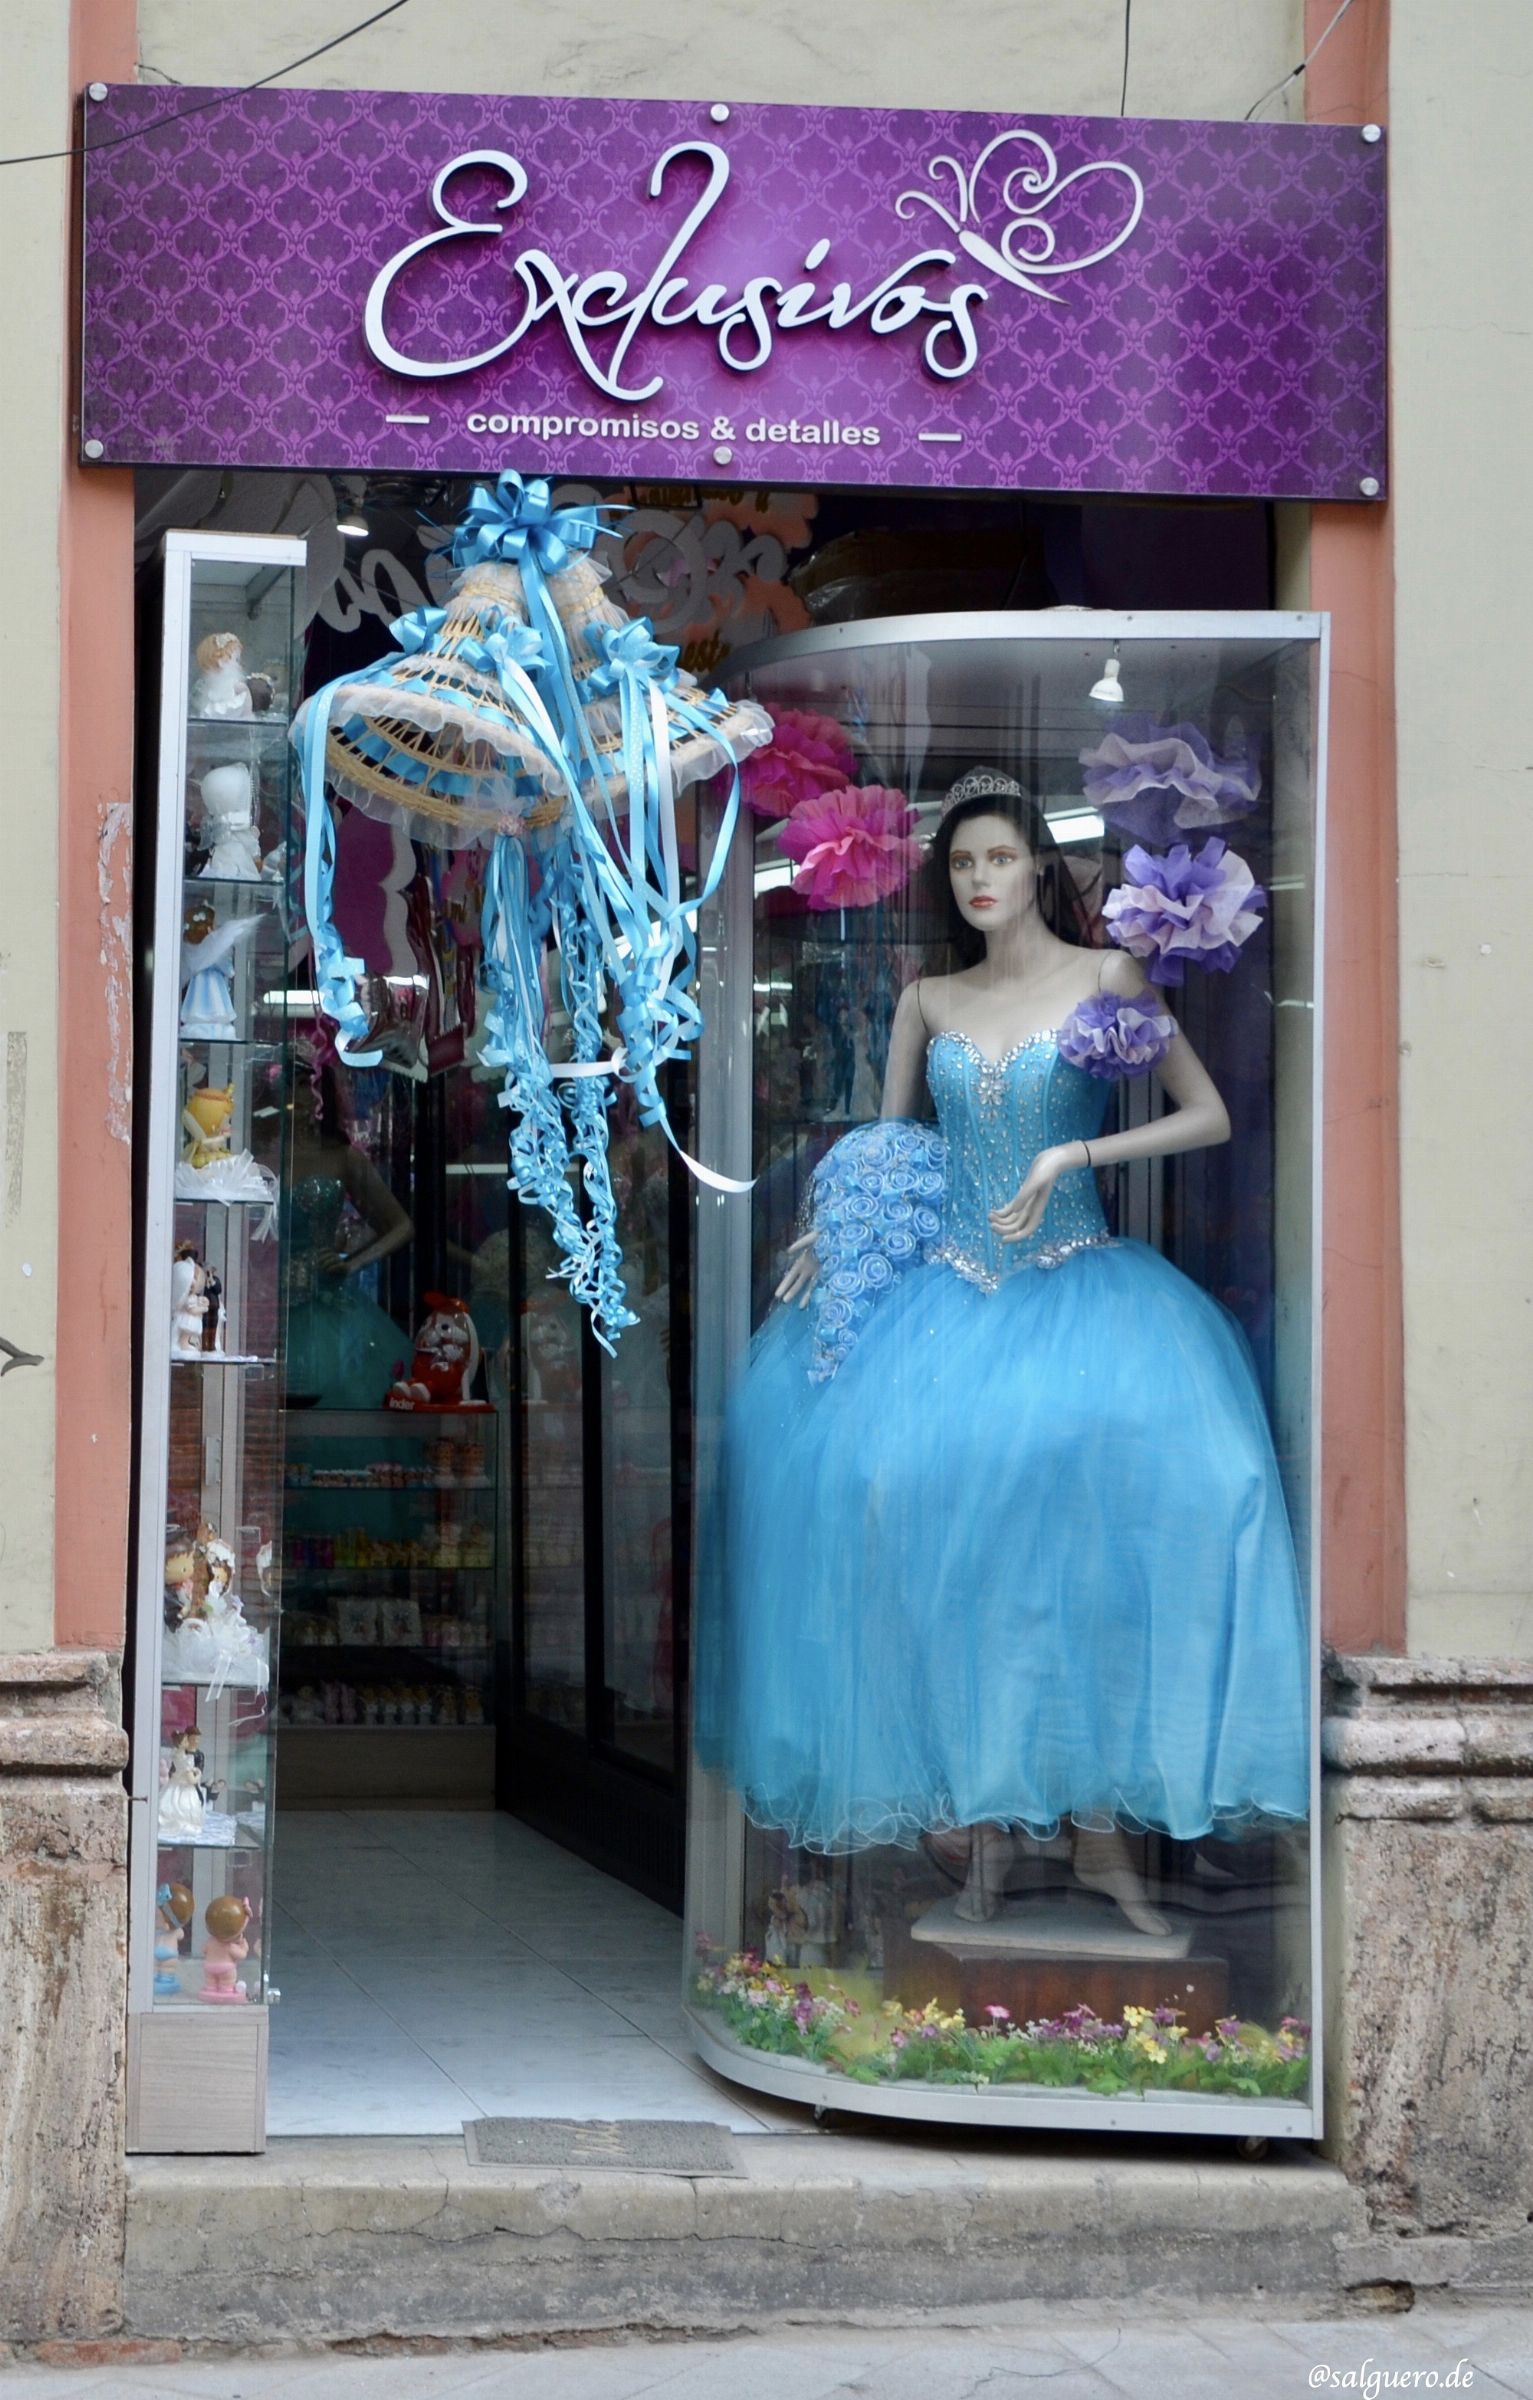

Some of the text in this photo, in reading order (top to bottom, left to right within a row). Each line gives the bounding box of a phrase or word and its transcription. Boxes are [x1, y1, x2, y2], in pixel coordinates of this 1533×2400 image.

[364, 140, 989, 401] Exclusivos
[466, 413, 881, 446] compromisos & detalles
